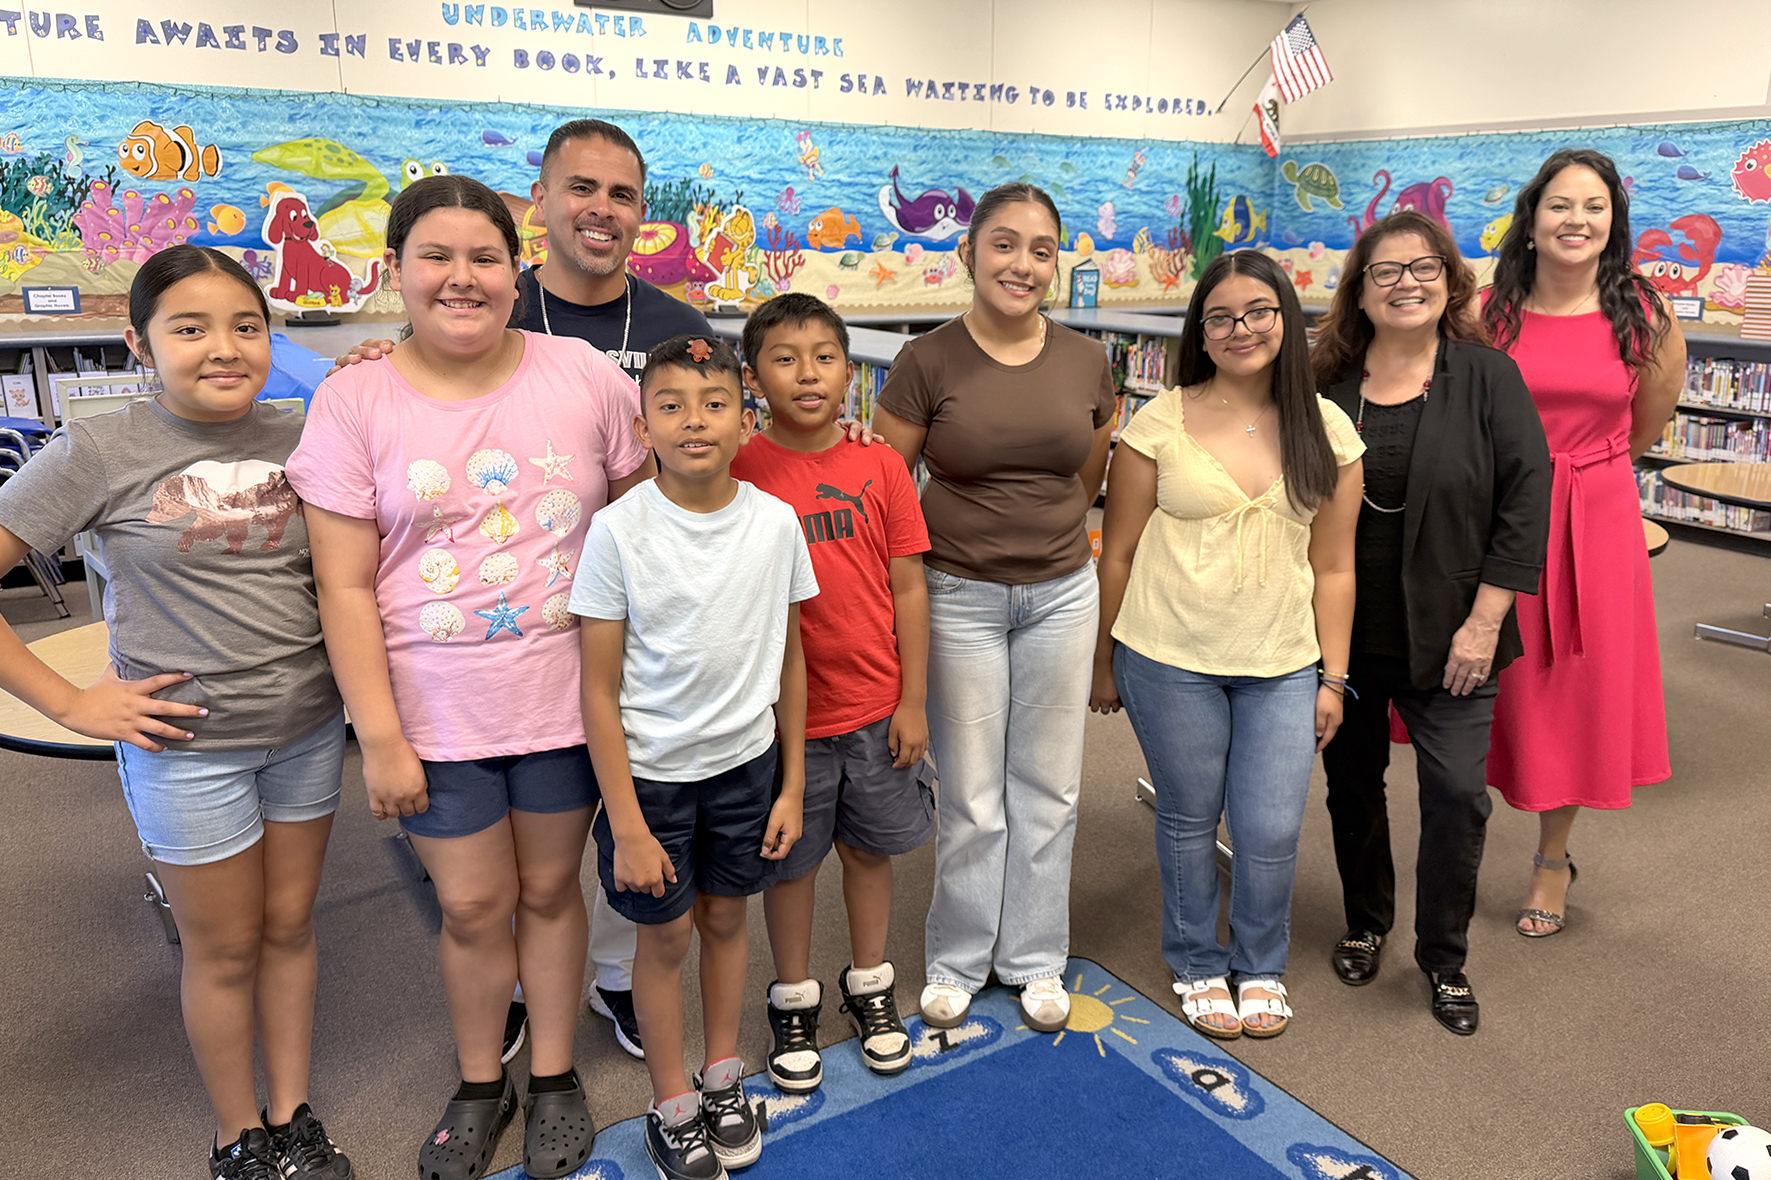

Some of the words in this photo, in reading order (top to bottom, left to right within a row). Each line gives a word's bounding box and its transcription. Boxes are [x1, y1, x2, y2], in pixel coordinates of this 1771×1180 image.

[441, 2, 648, 38] UNDERWATER
[686, 21, 845, 58] ADVENTURE
[0, 9, 104, 42] TURE
[135, 18, 299, 55] AWAITS
[319, 32, 367, 59] IN
[388, 37, 491, 68] EVERY
[513, 48, 617, 81] BOOK,
[635, 57, 711, 83] LIKE
[725, 64, 742, 86] A
[757, 65, 824, 90] VAST
[839, 72, 887, 96] SEA
[905, 77, 1021, 105] WAITING
[1029, 85, 1056, 108] TO
[1065, 90, 1089, 110] BE
[1104, 92, 1214, 117] EXPLORED.
[798, 508, 854, 544] MA
